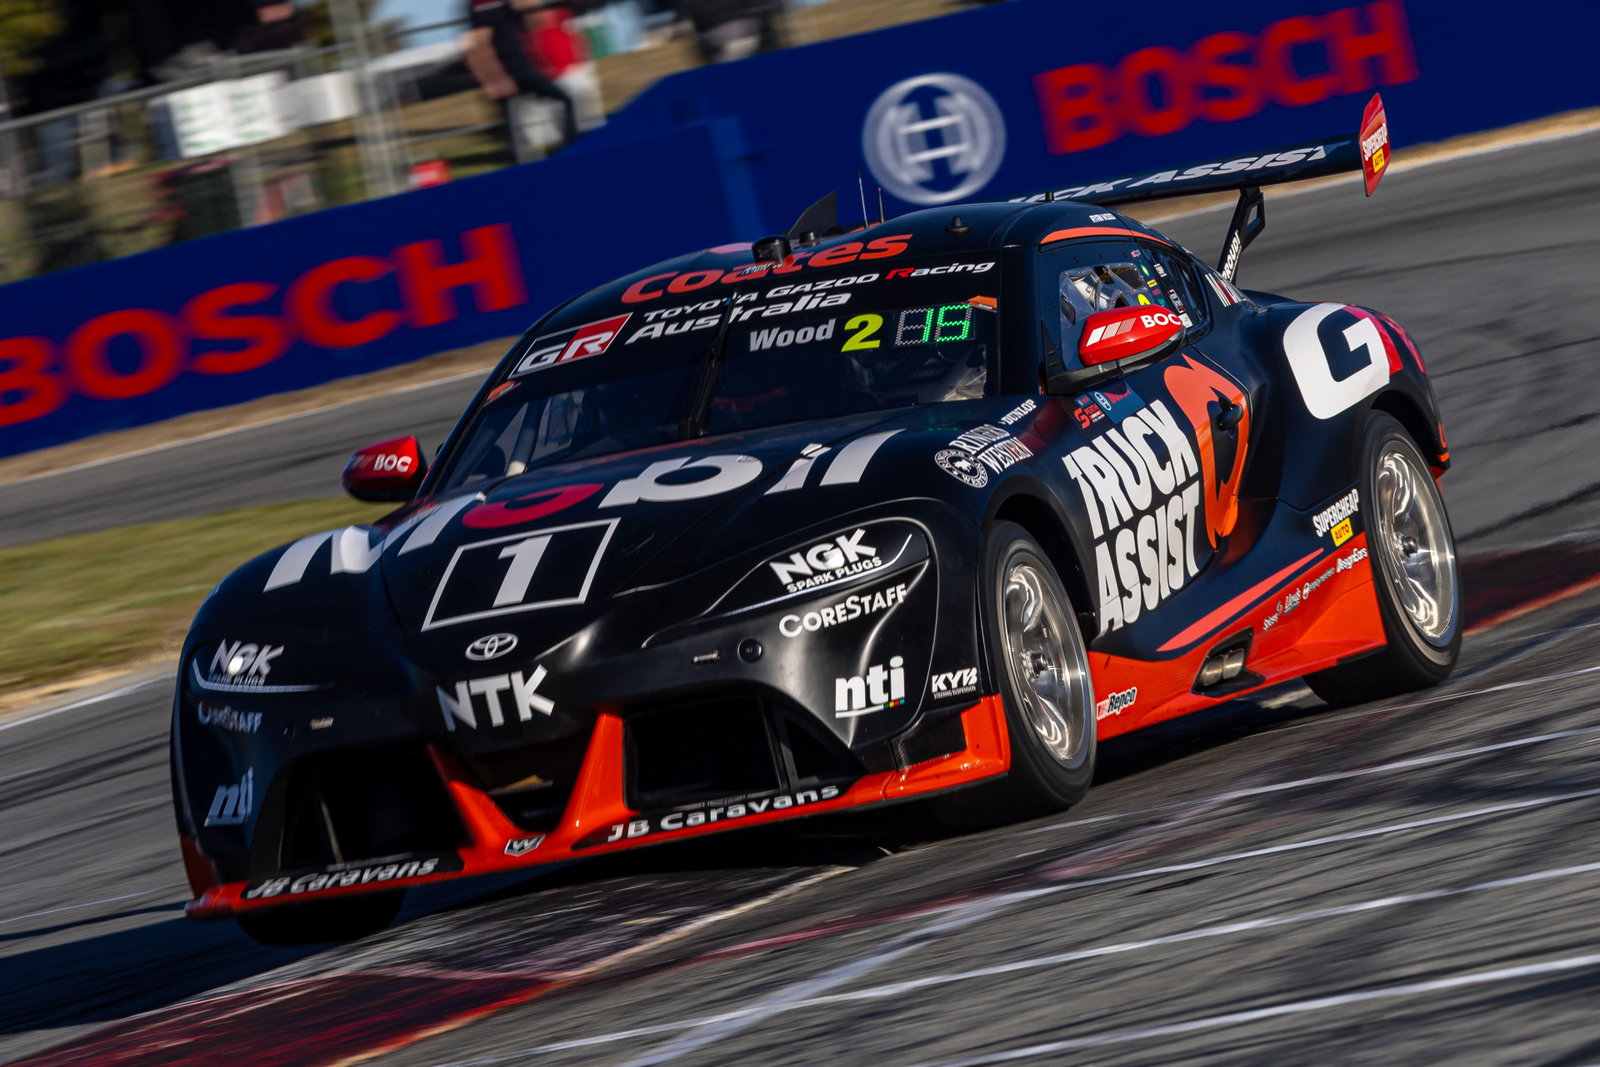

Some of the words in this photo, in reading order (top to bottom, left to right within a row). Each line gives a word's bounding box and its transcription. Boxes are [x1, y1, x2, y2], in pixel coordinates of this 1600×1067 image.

[1033, 0, 1418, 154] BOSCH
[621, 234, 913, 304] coates
[766, 273, 880, 299] GAZOO
[885, 261, 996, 281] Racing
[0, 222, 527, 427] BOSCH
[625, 291, 852, 345] Australia
[749, 320, 836, 352] Wood
[841, 314, 884, 352] 2
[1140, 313, 1182, 328] BOC
[516, 329, 615, 374] GR
[1001, 399, 1036, 425] DUNLOP
[373, 453, 413, 473] BOC
[1062, 399, 1198, 539] TRUCK
[1313, 488, 1359, 537] SUPERCHEAP
[1334, 523, 1350, 540] AUTO
[492, 533, 554, 608] 1
[769, 528, 877, 586] NGK
[787, 571, 835, 594] SPARK
[835, 556, 883, 580] PLUGS
[1095, 480, 1199, 637] ASSIST
[207, 638, 285, 677] NGK
[932, 667, 978, 693] KYB
[436, 664, 556, 733] NTK
[835, 655, 905, 712] nti
[1107, 689, 1137, 714] Repco
[608, 819, 651, 843] JB
[660, 785, 839, 831] Caravans
[246, 875, 291, 899] JB
[291, 858, 440, 894] Caravans
